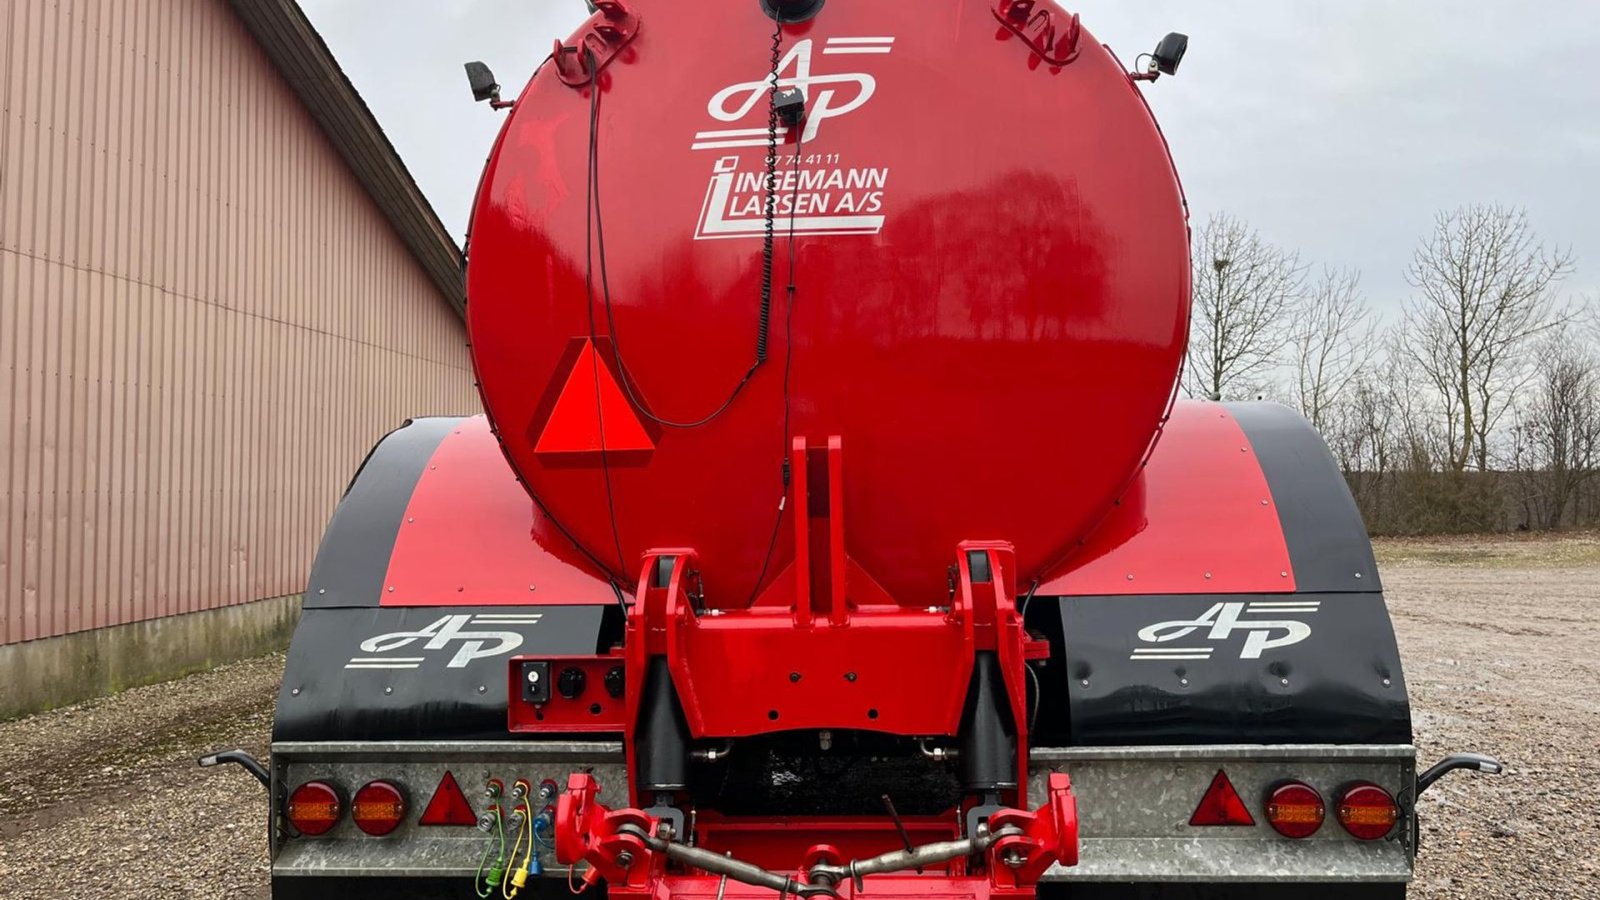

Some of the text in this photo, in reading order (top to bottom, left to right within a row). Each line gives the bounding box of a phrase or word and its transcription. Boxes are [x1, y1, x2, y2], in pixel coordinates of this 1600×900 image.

[707, 38, 876, 144] AP
[806, 154, 822, 165] 41
[826, 153, 840, 164] 11
[734, 168, 888, 193] INGEMANN
[729, 191, 884, 216] LARSEN A/S
[360, 614, 524, 668] AP
[1137, 602, 1311, 659] AP
